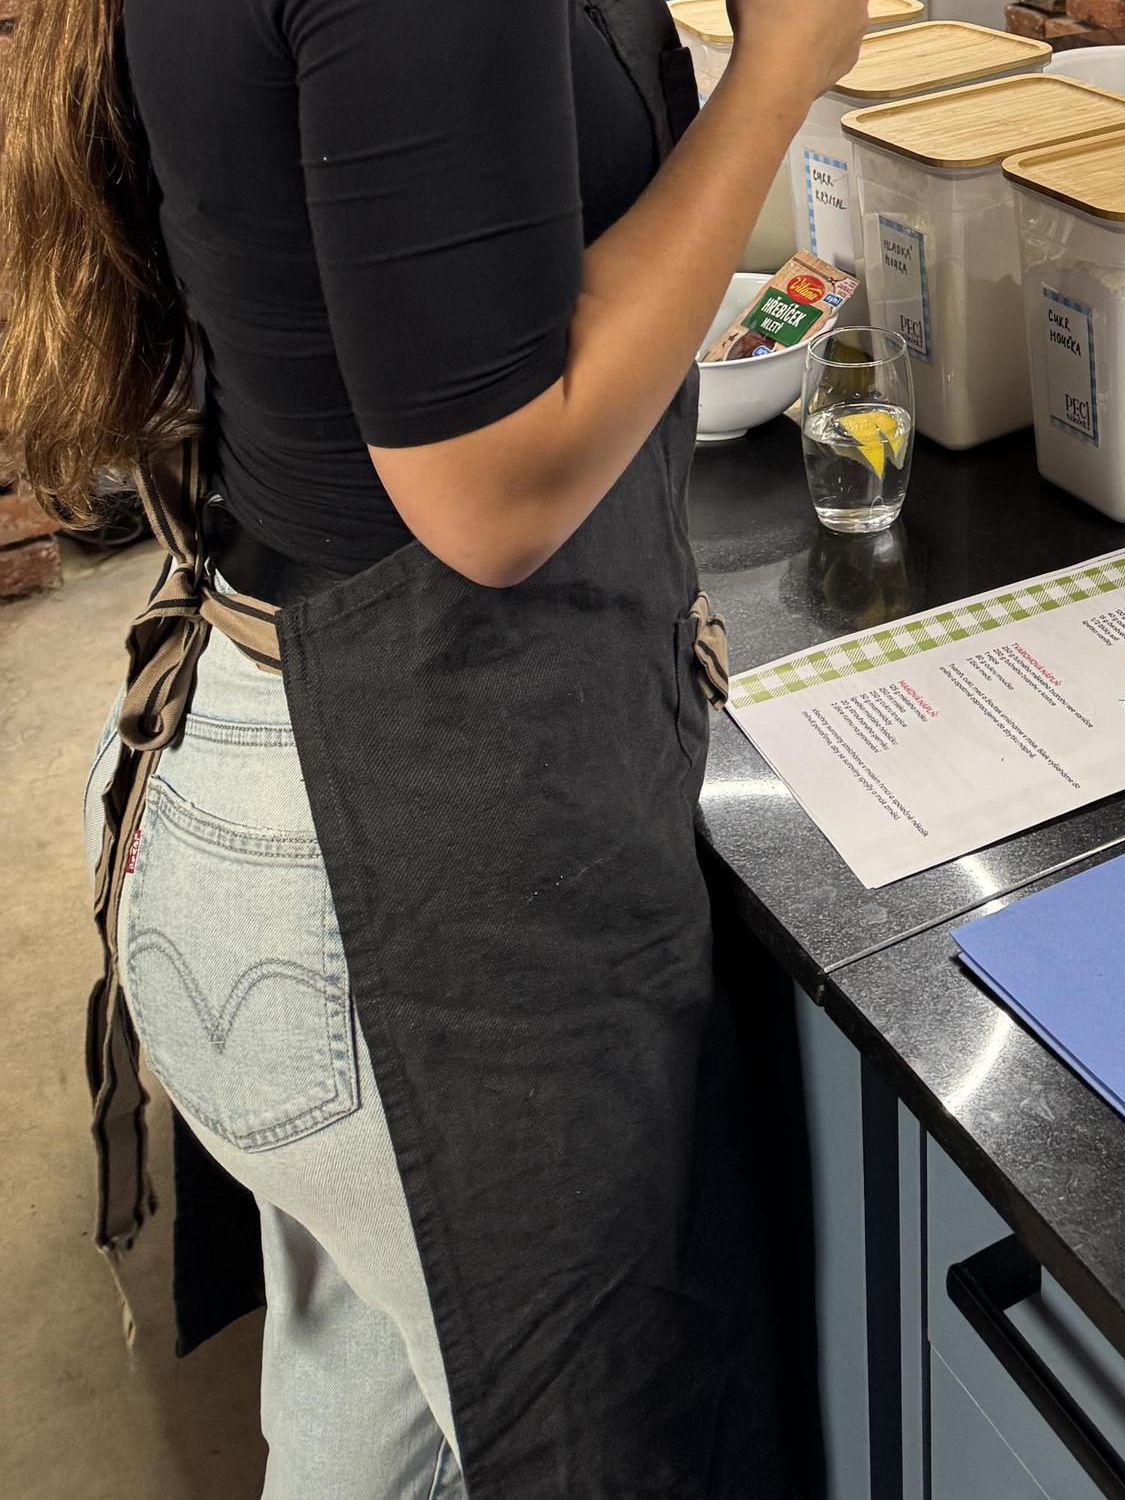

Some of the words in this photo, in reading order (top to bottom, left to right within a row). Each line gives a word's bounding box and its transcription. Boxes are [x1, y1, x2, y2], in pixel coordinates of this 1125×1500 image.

[790, 277, 822, 301] Vitana
[761, 297, 807, 328] HŘEBÍČEK
[1048, 309, 1071, 332] CUKR
[761, 318, 785, 334] MLETÝ
